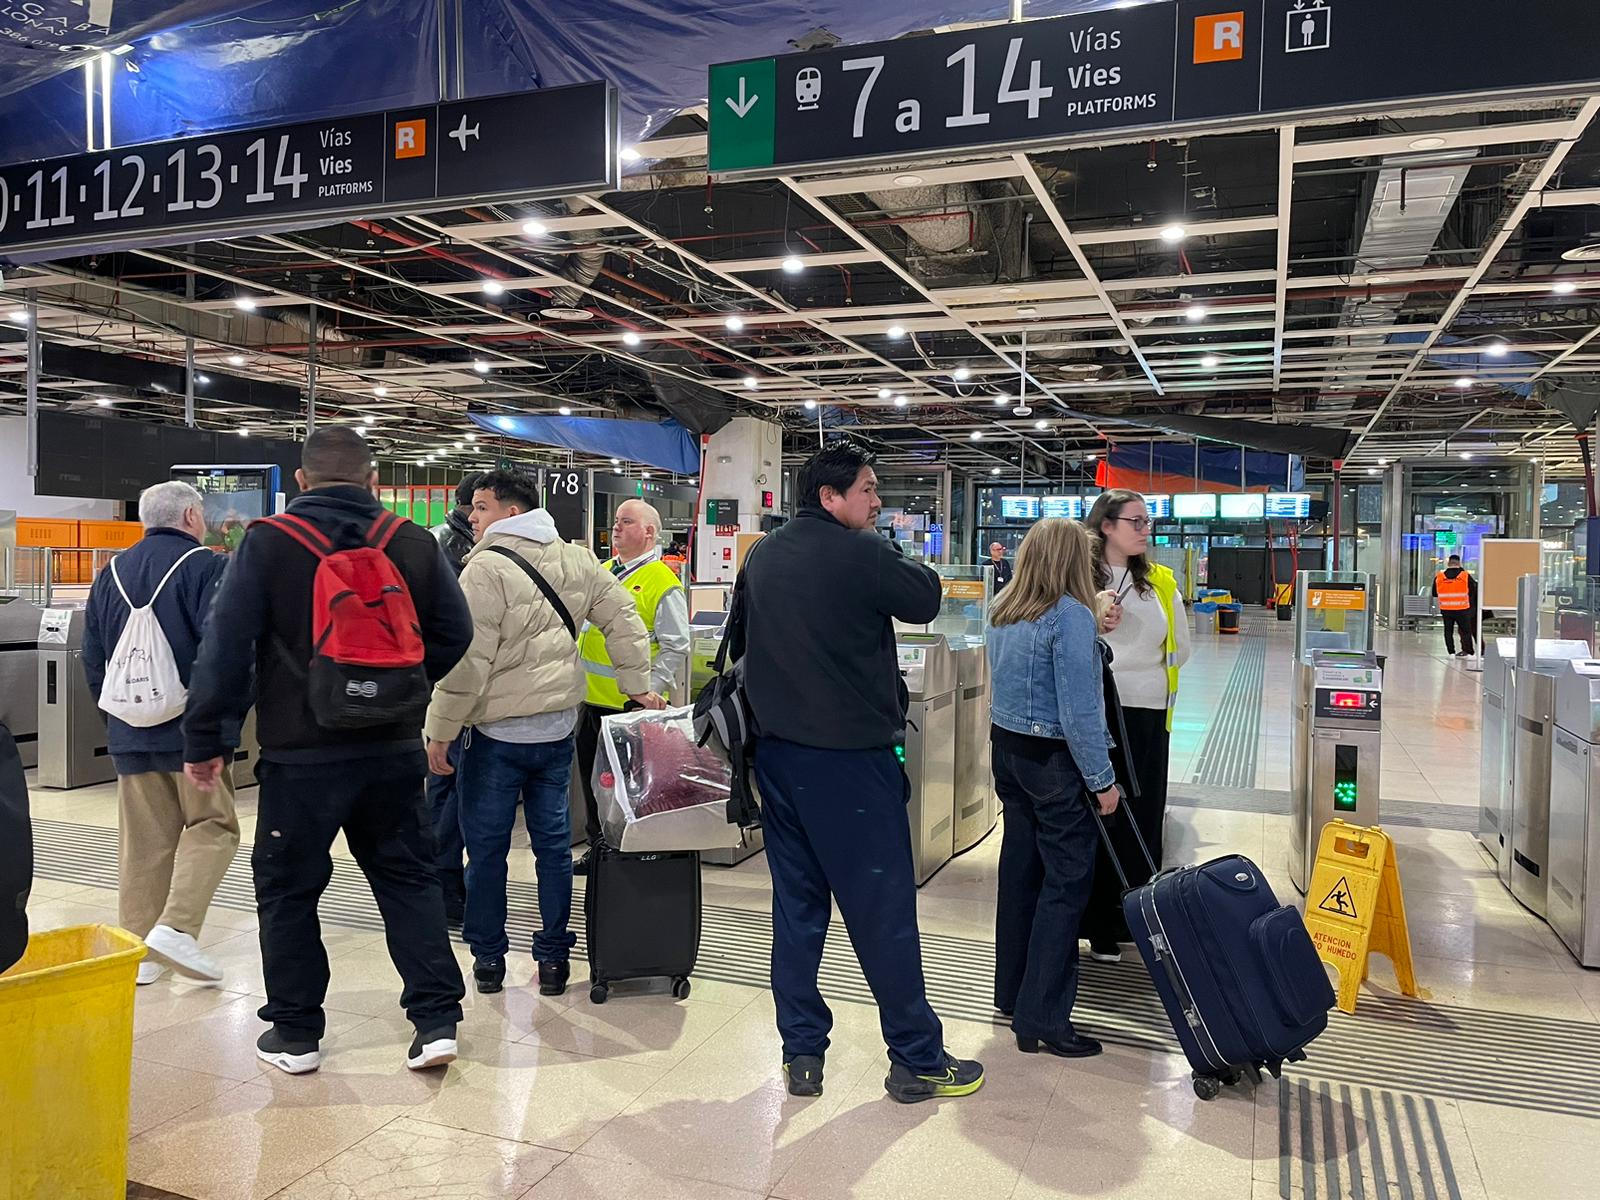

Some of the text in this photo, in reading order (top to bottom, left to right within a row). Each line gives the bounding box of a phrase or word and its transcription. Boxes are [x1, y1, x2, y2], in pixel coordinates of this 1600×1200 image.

[1069, 29, 1122, 54] Vías
[1068, 64, 1122, 89] Vies
[842, 37, 1054, 138] 7 a 14
[1067, 93, 1157, 117] PLATFORMS
[319, 128, 352, 148] Vías
[319, 156, 352, 176] Vies
[318, 180, 373, 197] PLATFORMS
[1313, 932, 1351, 949] ATENCION
[1327, 945, 1357, 960] HUMEDO
